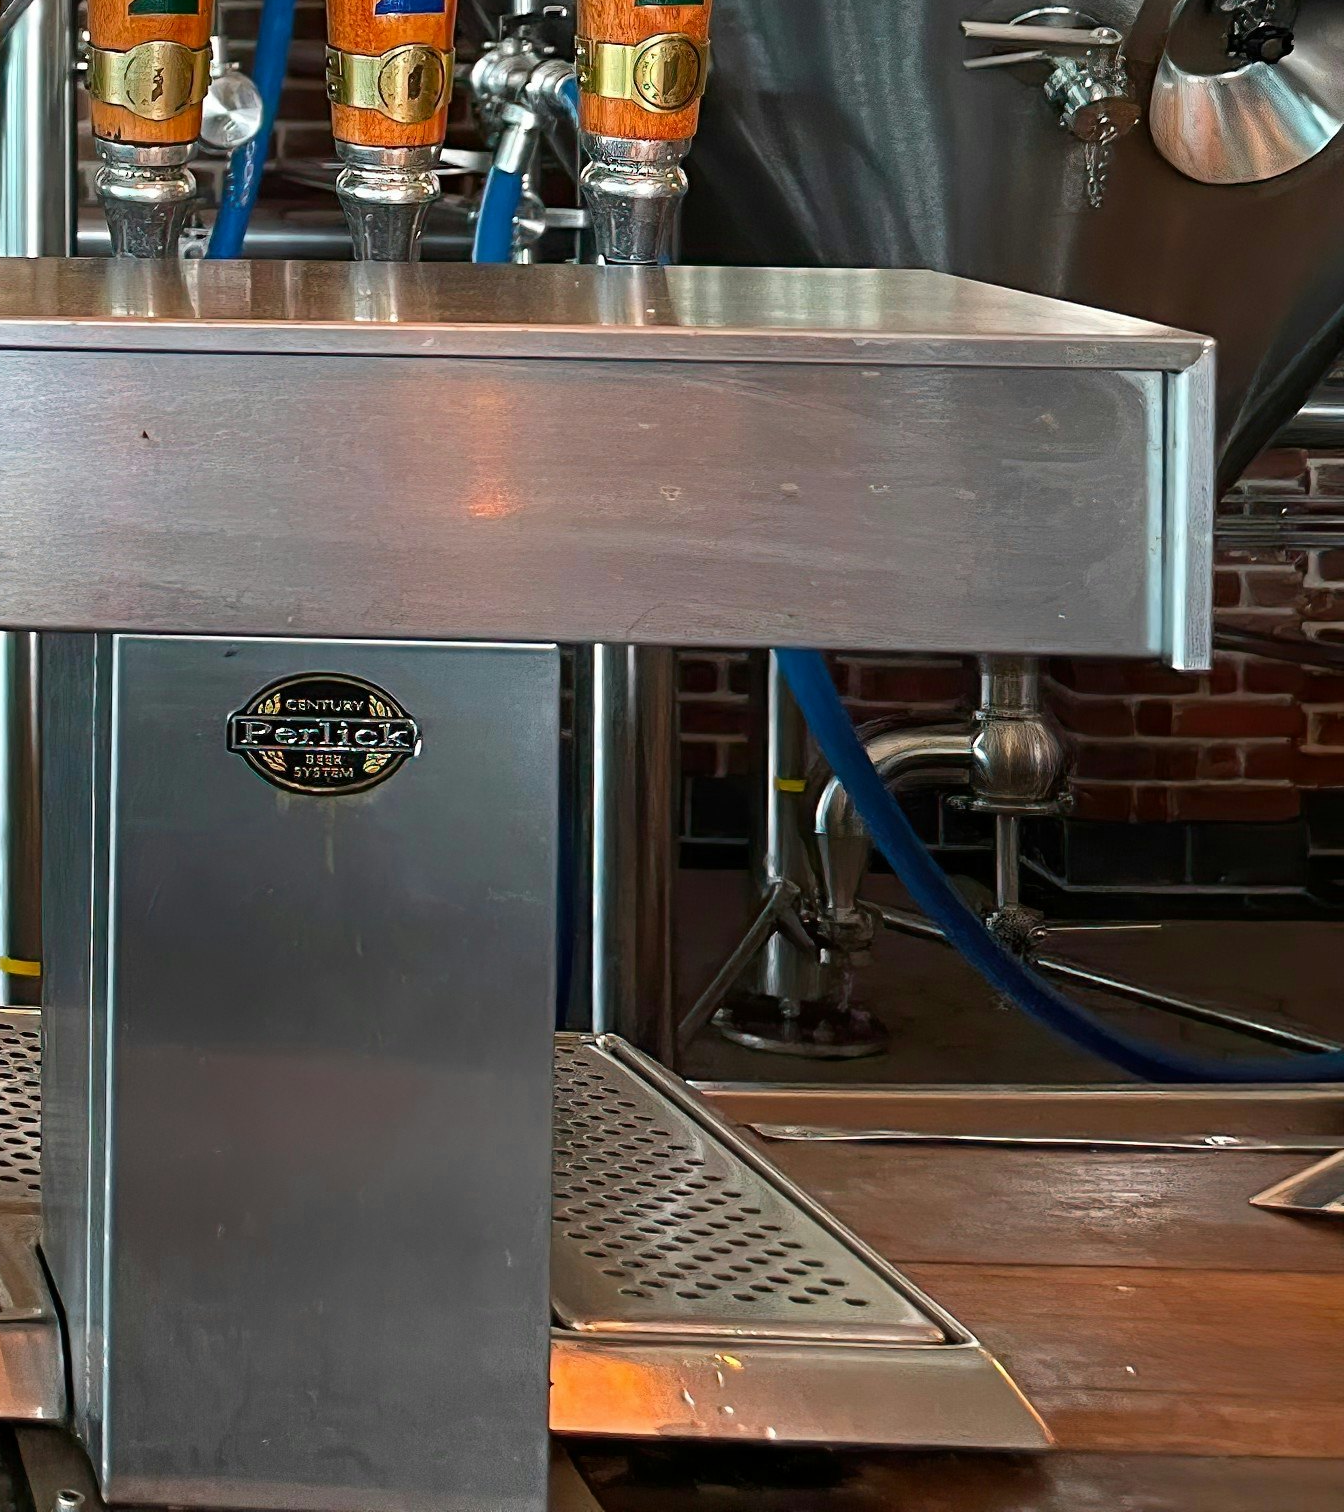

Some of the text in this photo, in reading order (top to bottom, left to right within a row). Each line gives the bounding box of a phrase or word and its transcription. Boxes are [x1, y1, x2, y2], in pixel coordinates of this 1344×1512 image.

[285, 699, 364, 712] CENTURY
[239, 721, 410, 747] Perlick
[305, 754, 342, 764] BEER
[293, 766, 354, 778] SYSTEM
